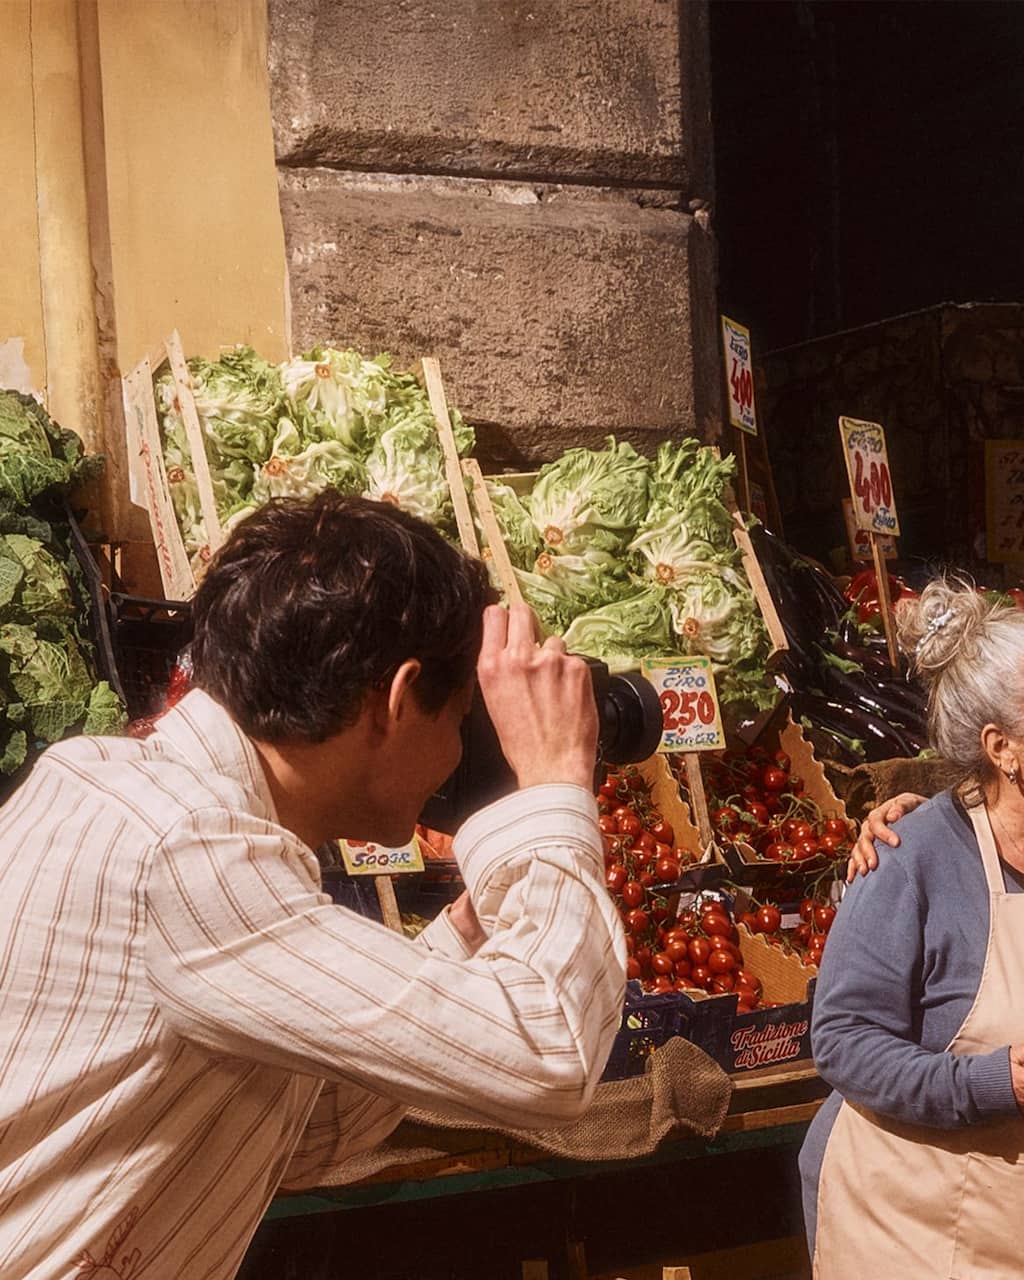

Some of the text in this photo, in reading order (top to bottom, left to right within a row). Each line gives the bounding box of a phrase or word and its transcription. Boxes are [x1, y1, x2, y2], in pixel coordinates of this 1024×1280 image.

[663, 675, 706, 689] CIRO
[730, 1020, 809, 1051] Tradizione
[735, 1039, 801, 1069] di Sicilia
